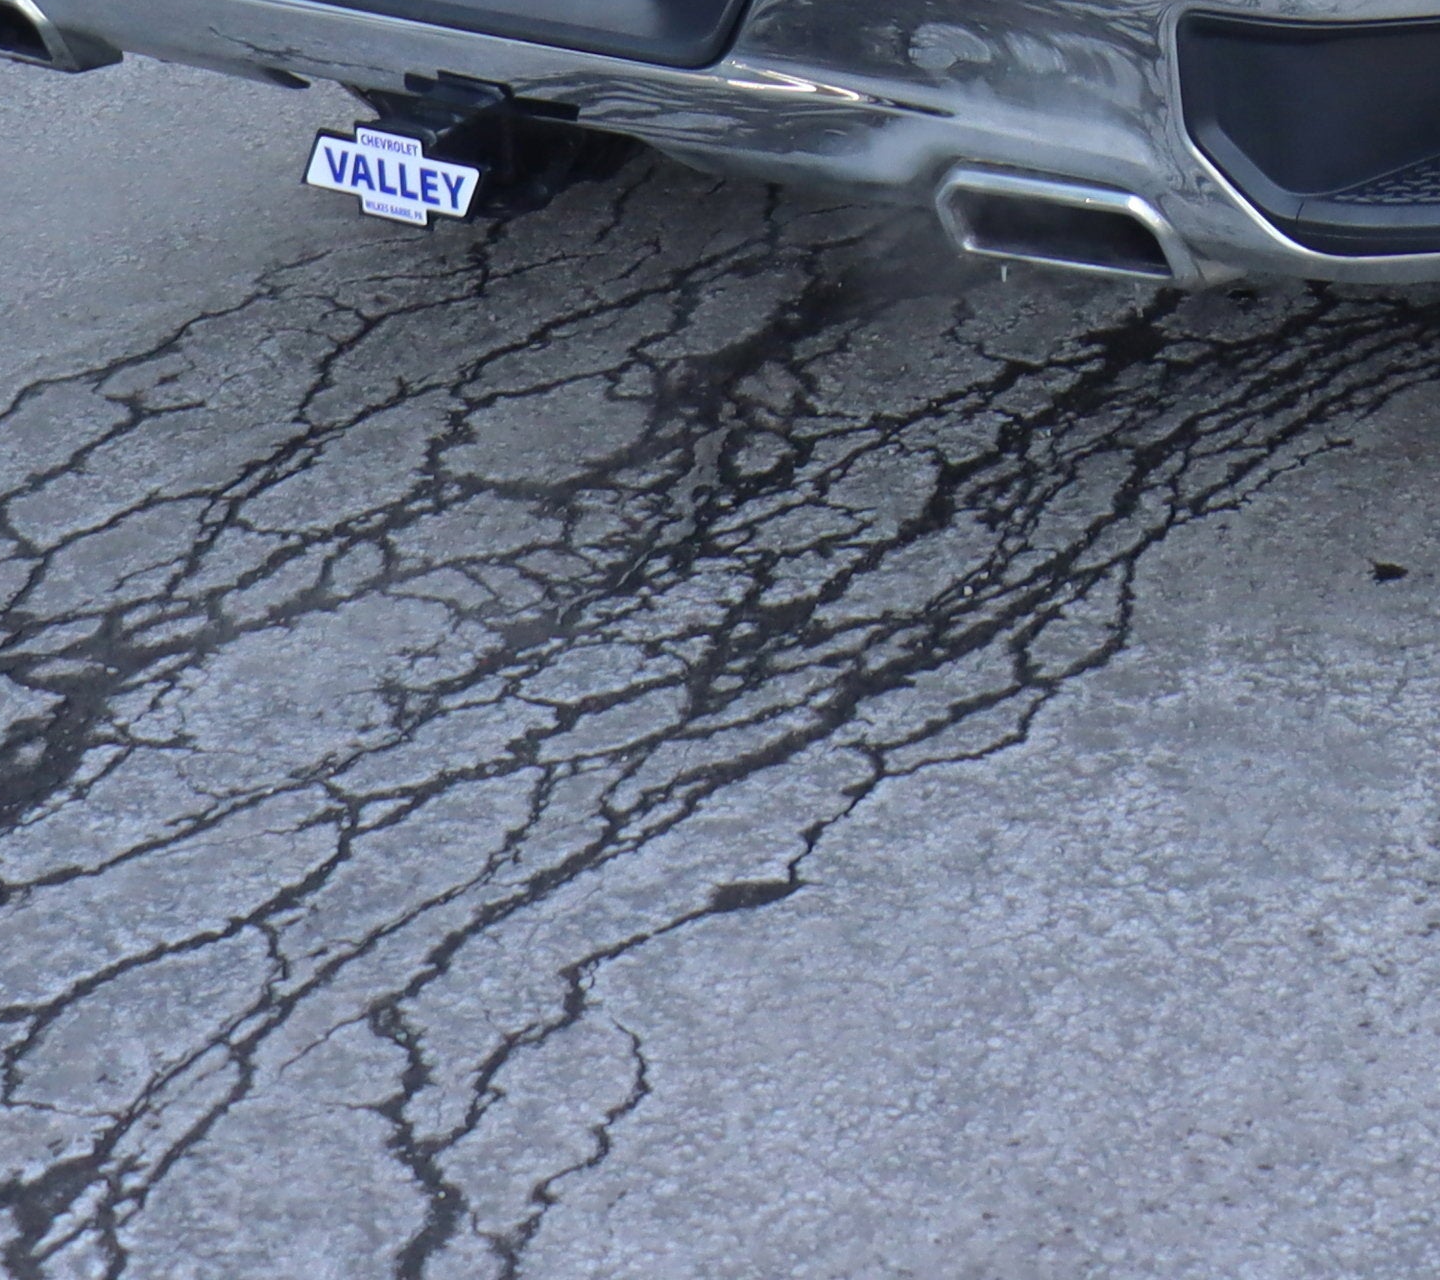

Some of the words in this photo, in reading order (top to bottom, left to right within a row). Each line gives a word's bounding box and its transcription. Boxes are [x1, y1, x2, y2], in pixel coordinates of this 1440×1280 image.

[360, 133, 419, 157] CHEVROLET
[323, 145, 466, 210] VALLEY
[365, 199, 389, 213] WILKES
[414, 210, 423, 221] PA
